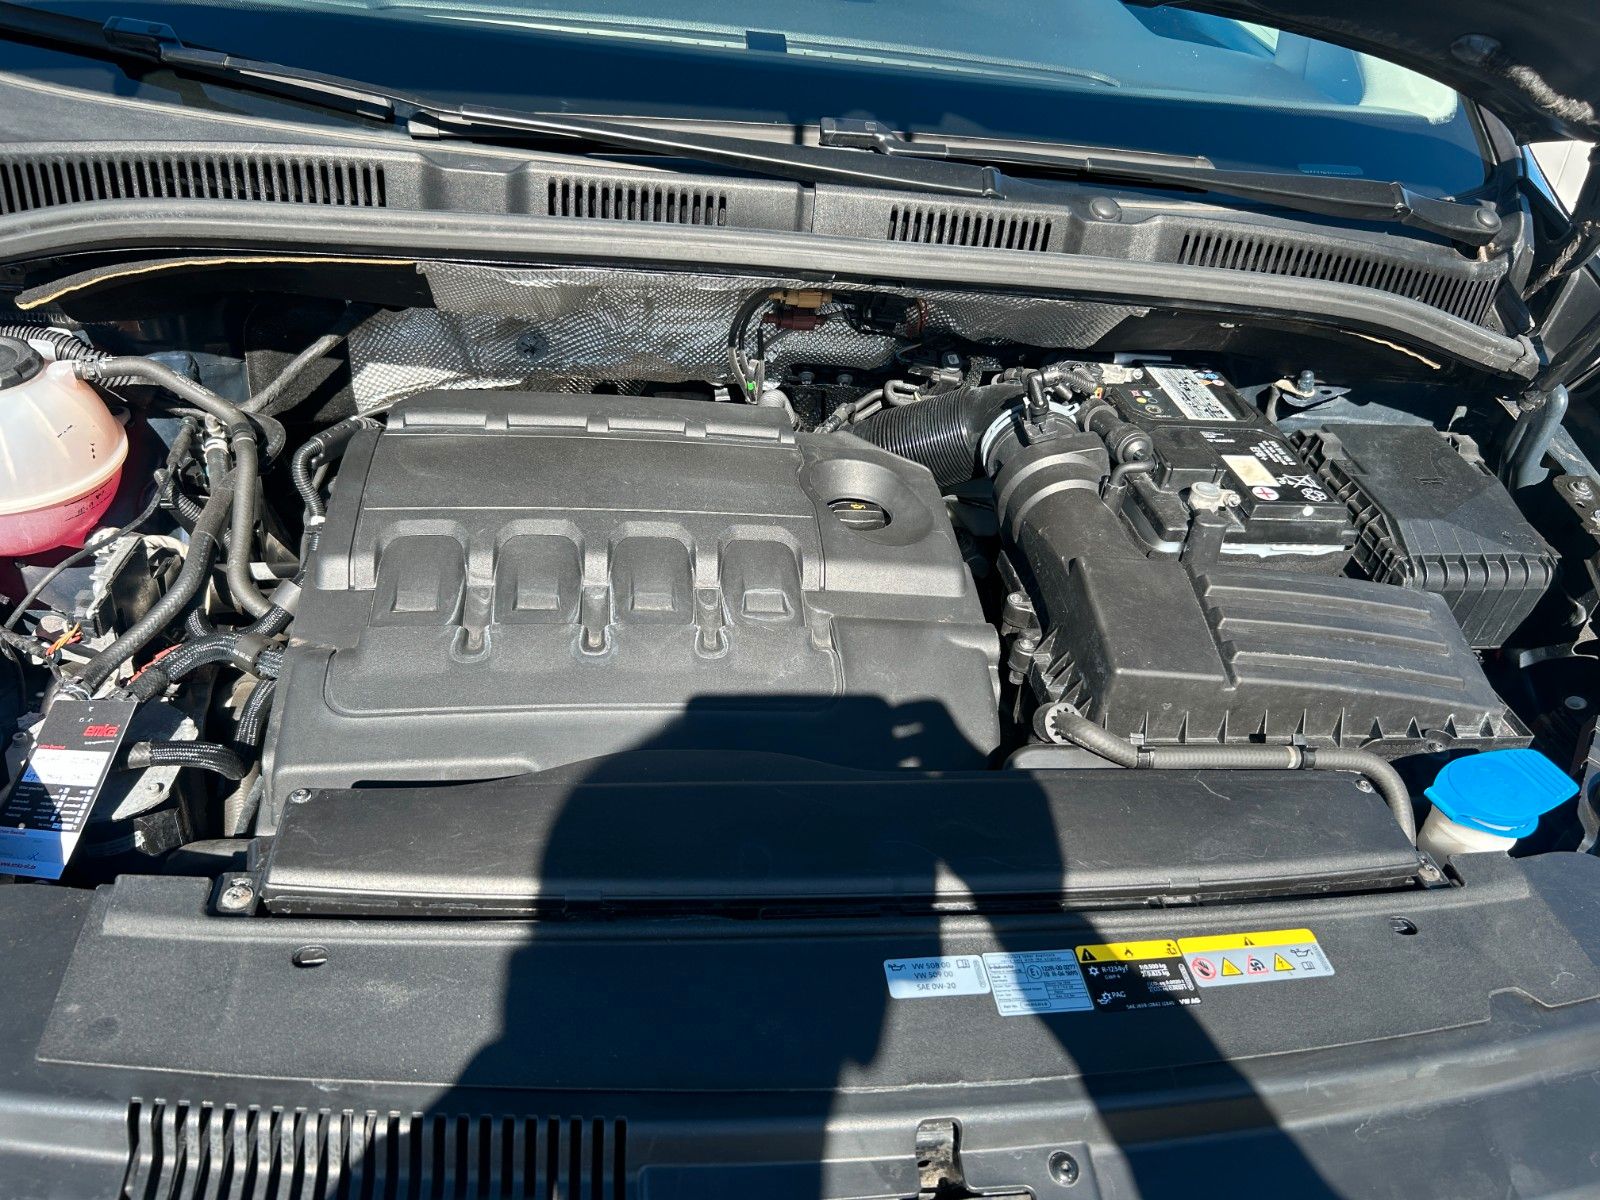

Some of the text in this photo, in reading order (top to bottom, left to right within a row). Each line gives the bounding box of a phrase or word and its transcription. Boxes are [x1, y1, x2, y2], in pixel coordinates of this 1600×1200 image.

[911, 961, 951, 970] VW 508 00
[928, 971, 942, 979] 509
[944, 970, 954, 978] 00
[916, 983, 930, 991] SAE
